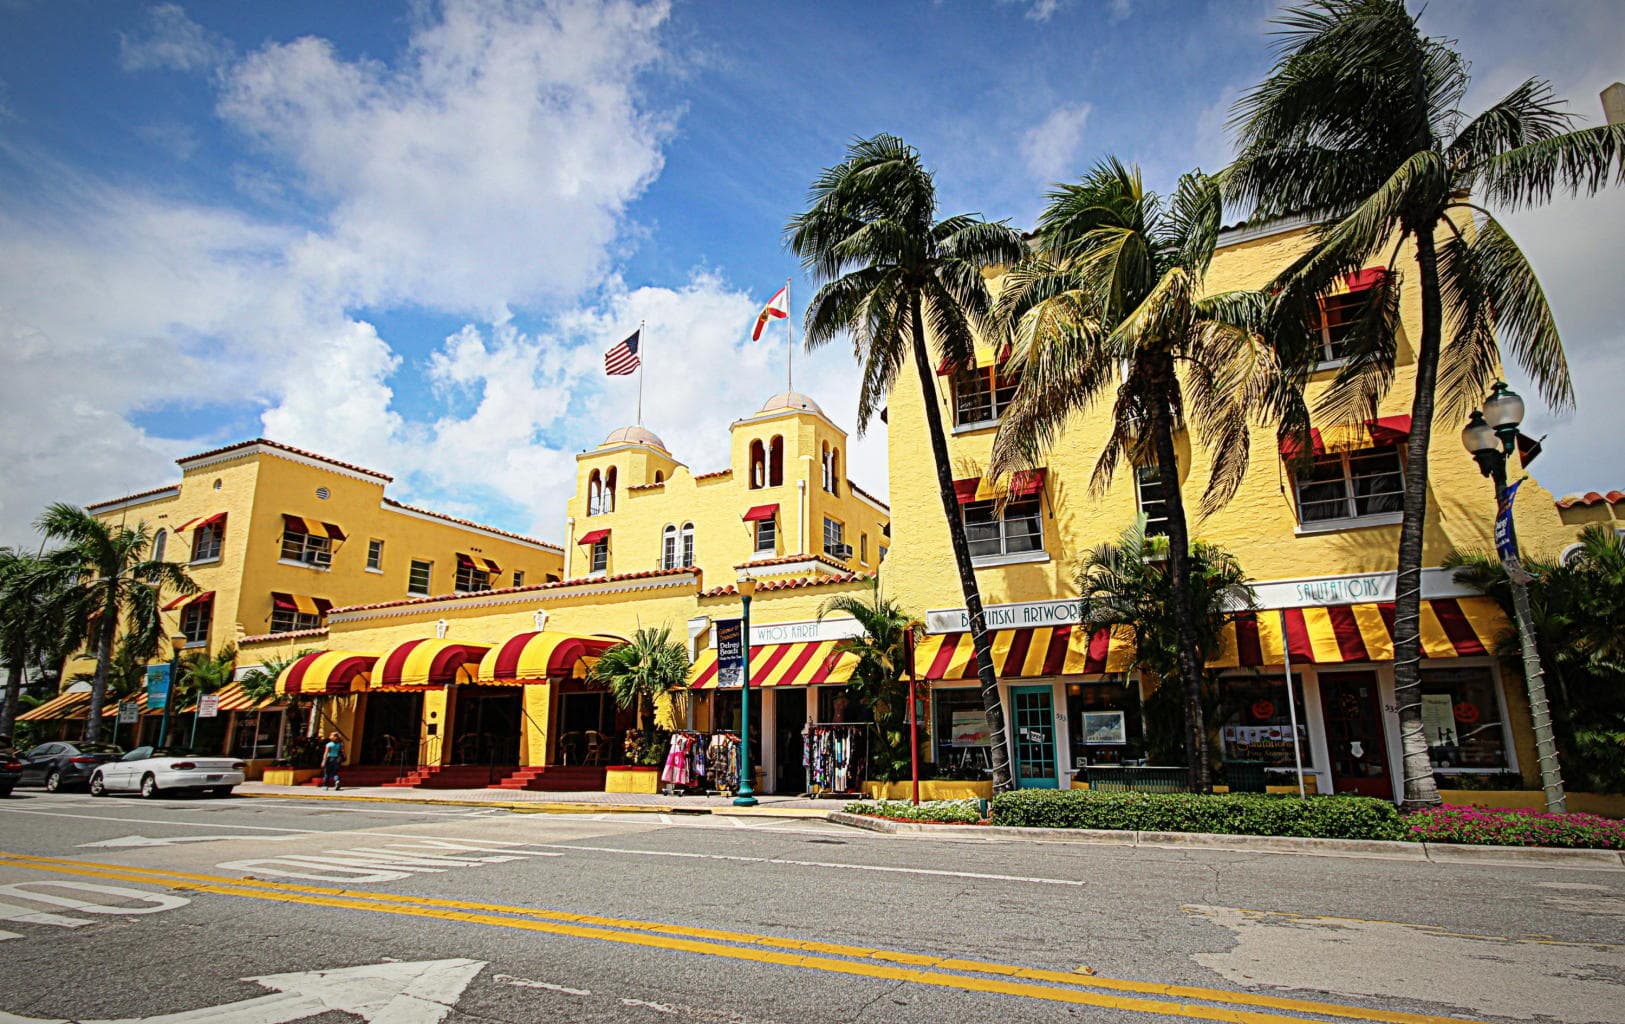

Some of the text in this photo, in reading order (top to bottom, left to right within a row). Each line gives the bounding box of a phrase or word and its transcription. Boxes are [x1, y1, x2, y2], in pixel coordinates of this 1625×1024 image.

[1296, 578, 1379, 601] SALUTATIONS
[1023, 603, 1082, 623] ARTWOR
[791, 624, 819, 639] KAREN
[720, 648, 739, 656] Beach
